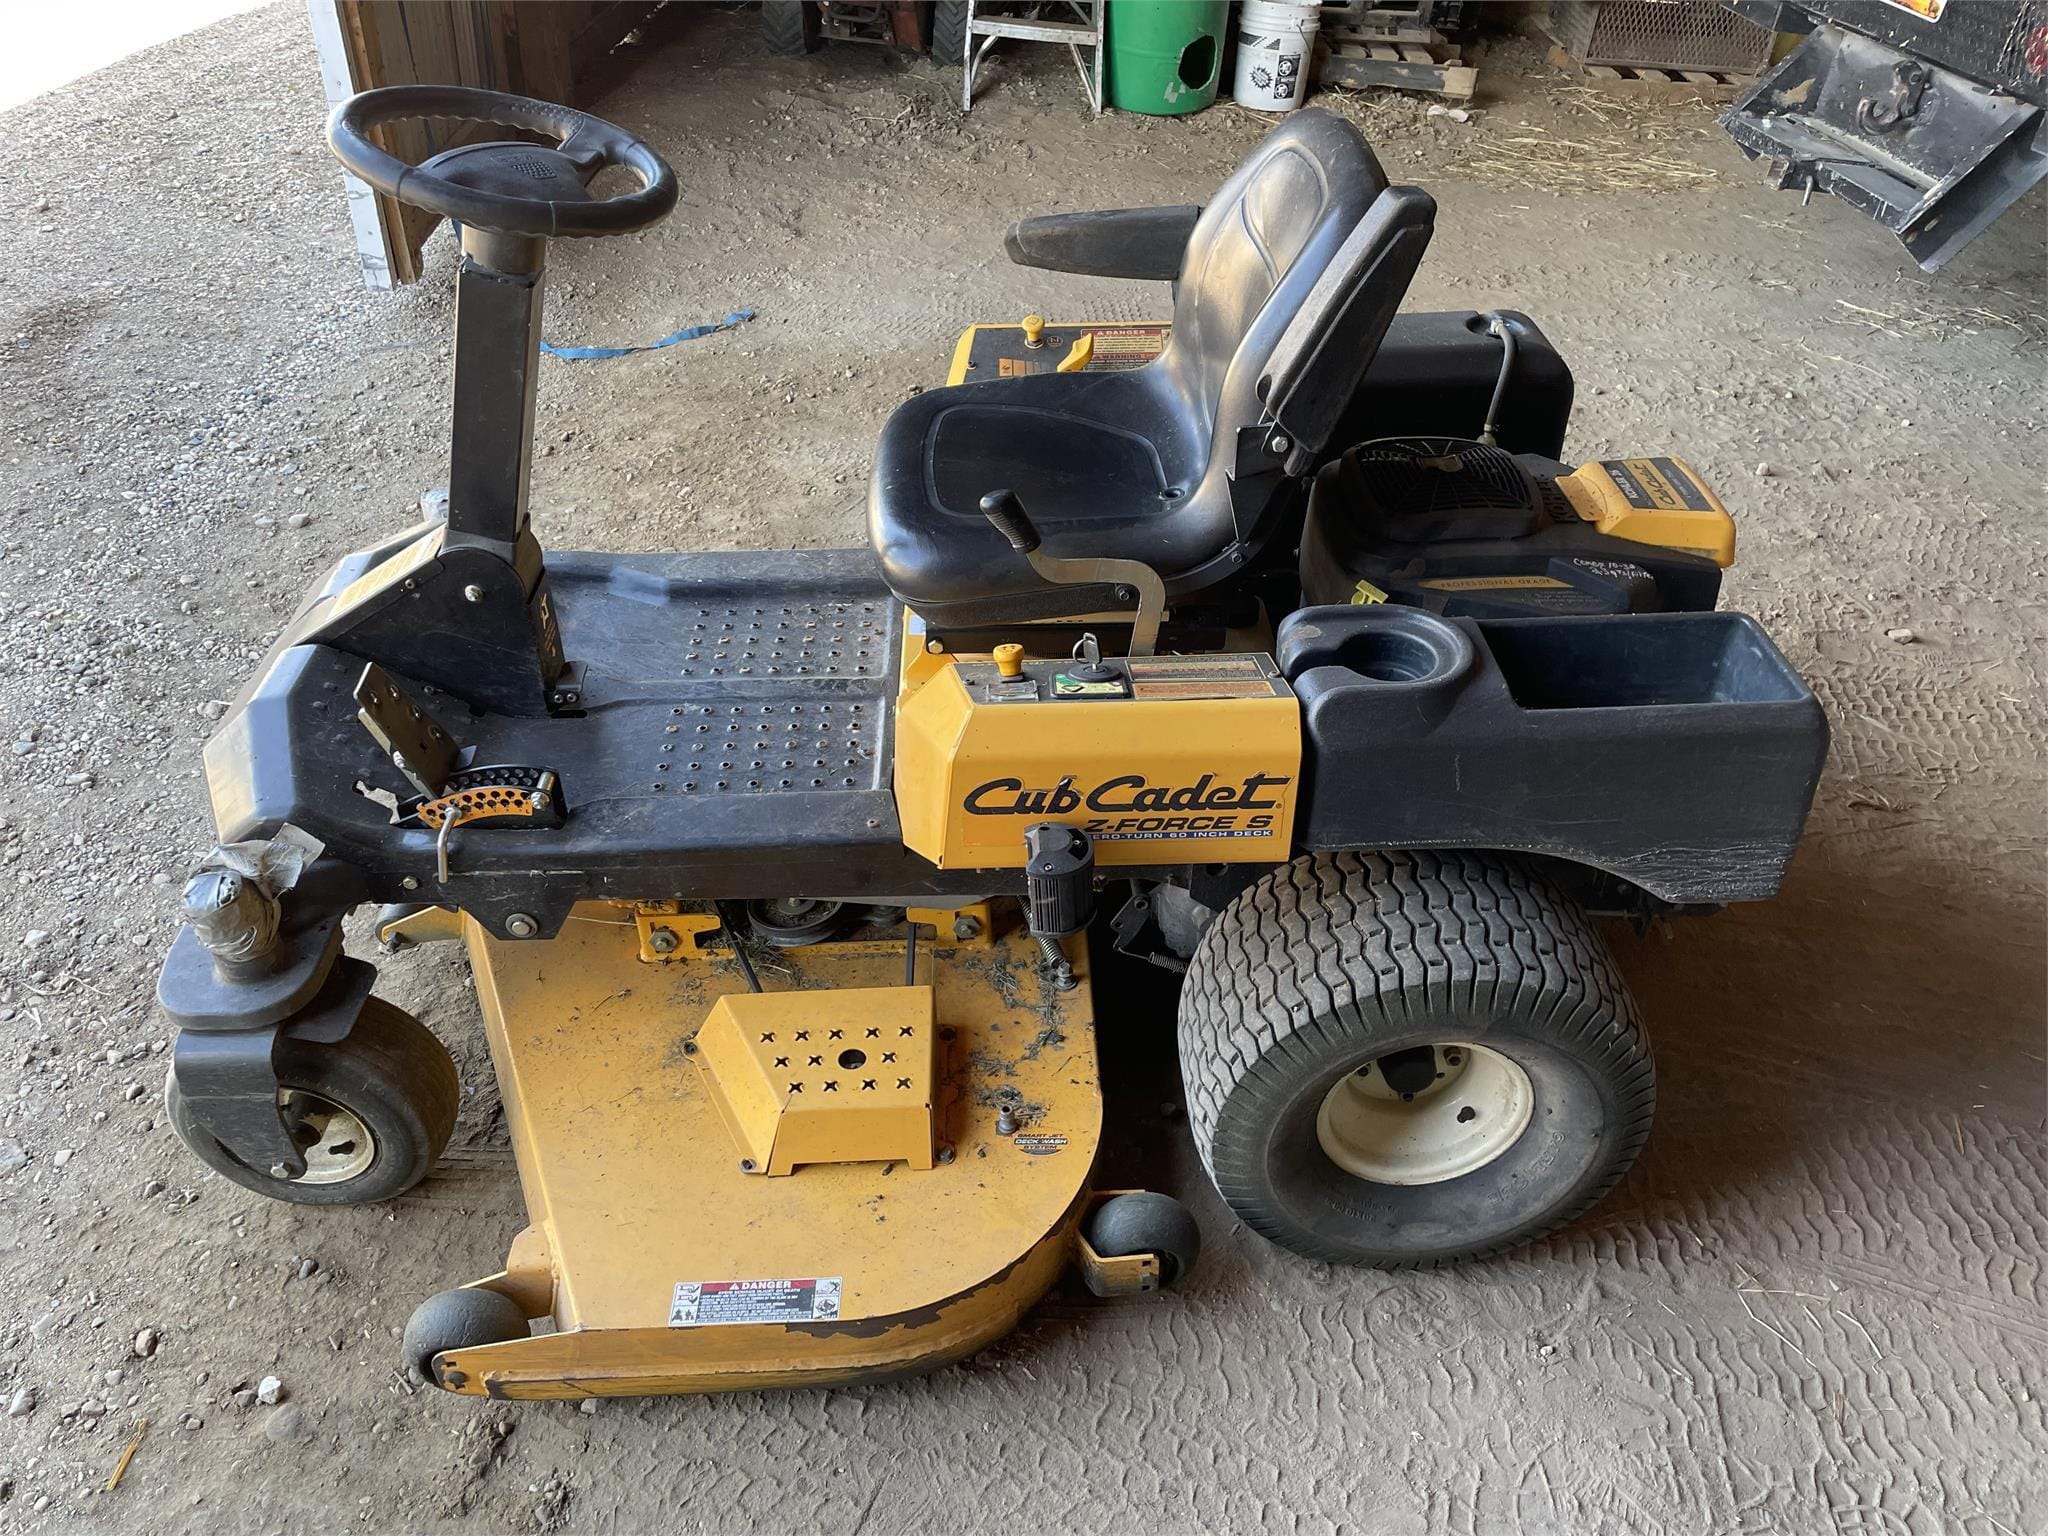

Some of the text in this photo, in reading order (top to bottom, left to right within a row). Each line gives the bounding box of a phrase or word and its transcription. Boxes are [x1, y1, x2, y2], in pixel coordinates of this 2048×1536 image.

[1653, 488, 1677, 505] Cub
[1440, 578, 1514, 588] PROFESSIONAL
[963, 773, 1290, 815] Cub Cadet
[1085, 815, 1274, 833] Z-FORCE S
[1092, 832, 1164, 841] ERO-TURN
[1193, 830, 1228, 838] INCH
[1233, 829, 1272, 837] DECK
[741, 1280, 792, 1290] DANGER
